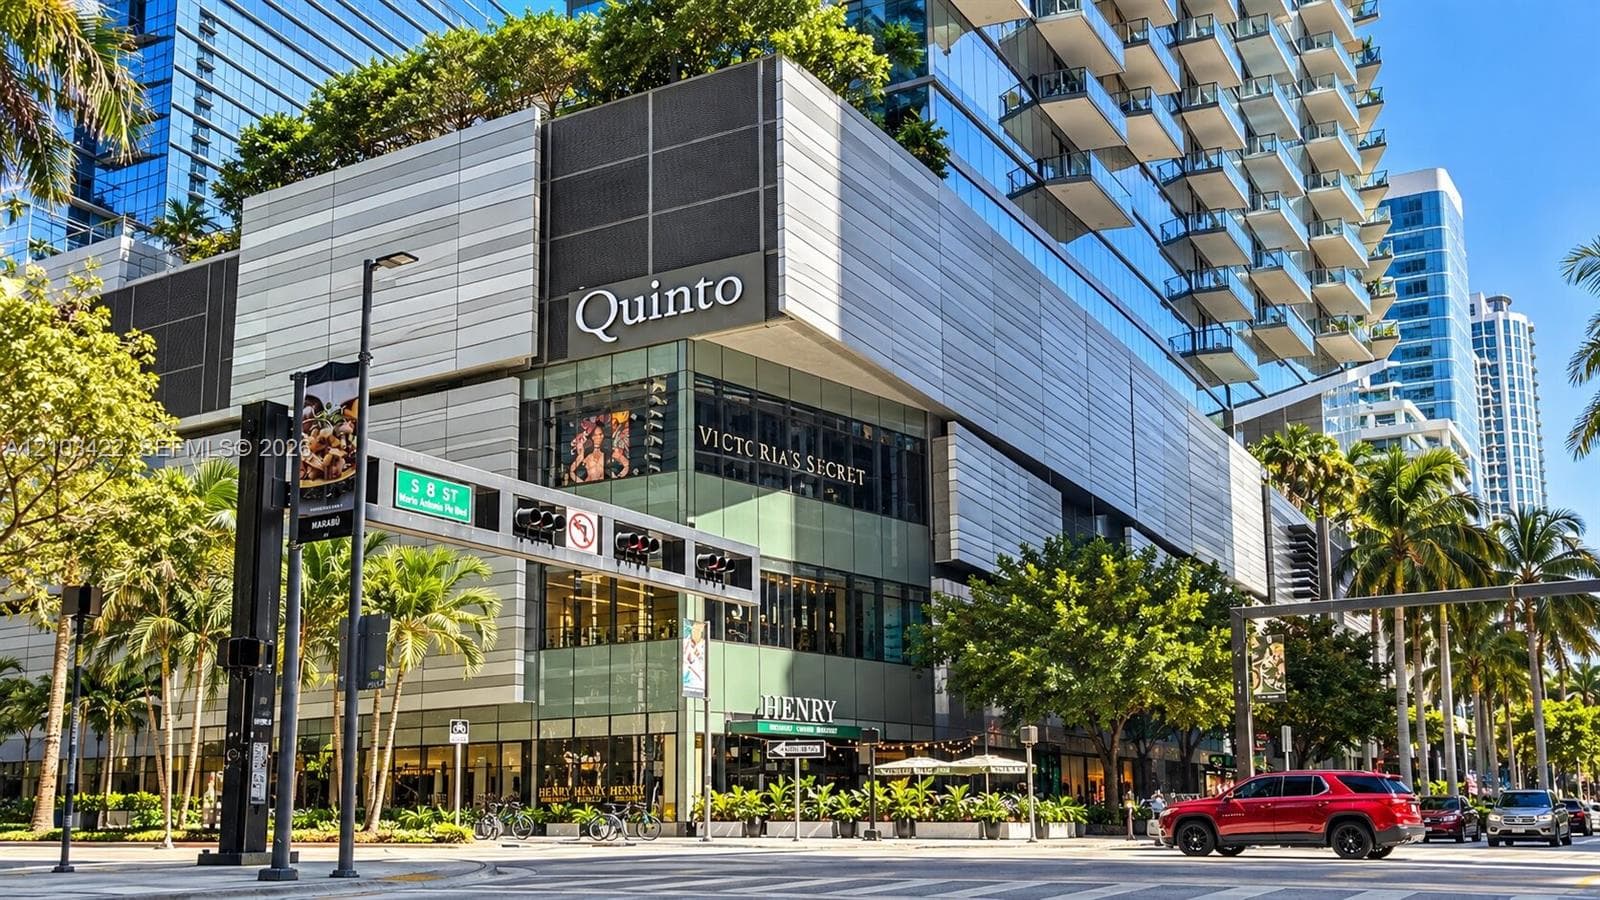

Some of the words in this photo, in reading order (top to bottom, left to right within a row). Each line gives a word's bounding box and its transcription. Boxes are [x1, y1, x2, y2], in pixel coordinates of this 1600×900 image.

[575, 275, 743, 343] Quinto
[698, 425, 801, 470] VICTORIA'S
[806, 455, 866, 486] SECRET
[410, 479, 420, 494] S
[426, 482, 436, 498] 8
[442, 487, 459, 503] ST
[311, 515, 341, 530] MARABÚ
[762, 694, 837, 723] HENRY
[539, 786, 571, 798] HENRY
[610, 784, 645, 797] HENRY
